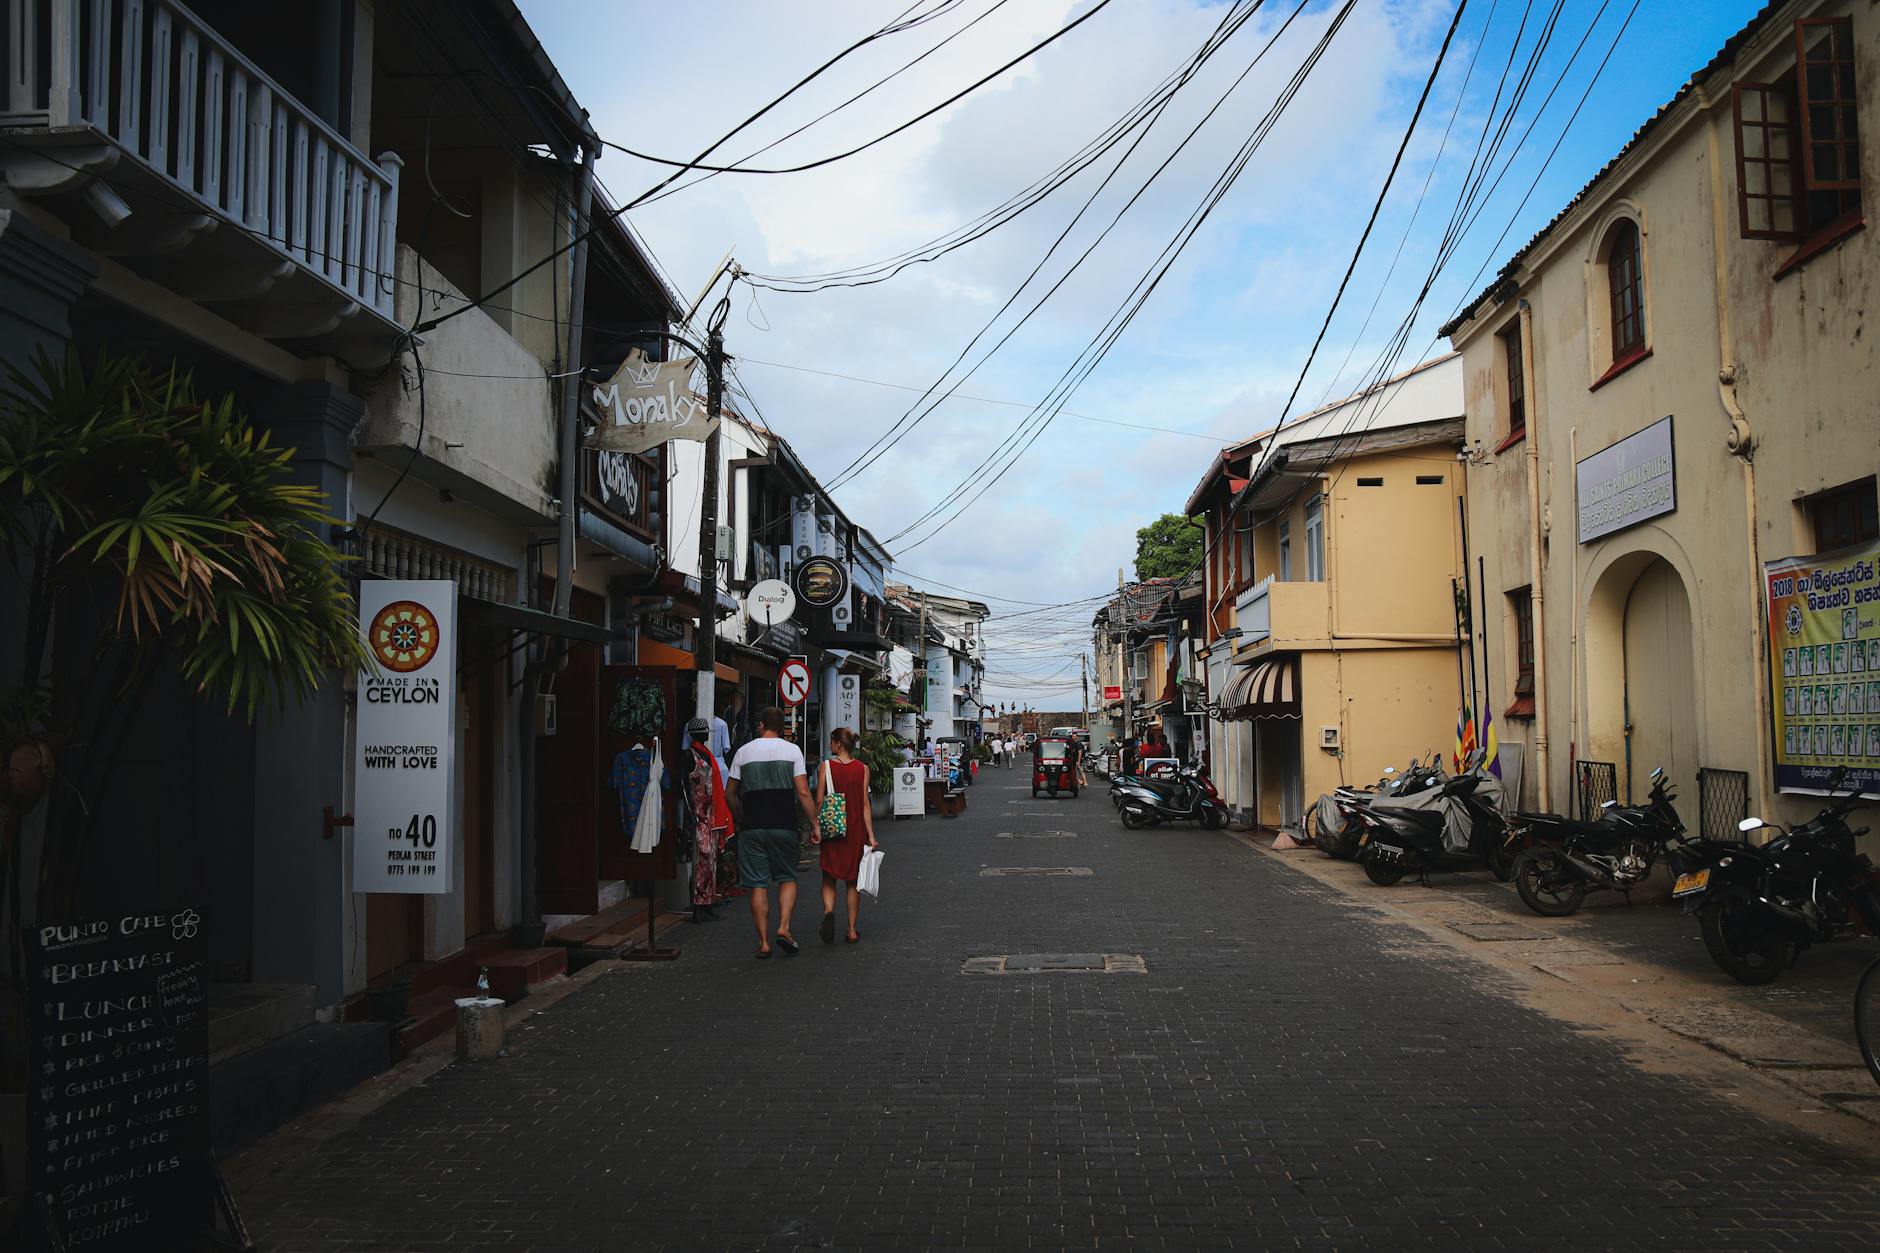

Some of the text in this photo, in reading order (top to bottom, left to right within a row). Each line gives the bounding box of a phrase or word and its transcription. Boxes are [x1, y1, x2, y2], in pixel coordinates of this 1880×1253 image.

[593, 379, 698, 432] Monaky
[1642, 453, 1670, 484] COLLEGE
[1773, 576, 1793, 599] 2018
[758, 595, 785, 606] Dialog
[377, 677, 429, 687] MADE IN
[366, 686, 439, 704] CEYLON
[364, 744, 438, 756] HANDCRAFTED
[365, 755, 438, 769] WITH LOVE
[389, 814, 437, 848] no 40
[388, 850, 436, 861] PEDLAR STREET
[387, 864, 436, 876] 0775 199 199
[40, 915, 166, 947] PUNTO CAFE
[52, 951, 175, 984] BREAKFAST
[57, 994, 153, 1021] LUNCH
[61, 1018, 154, 1047] DINNER
